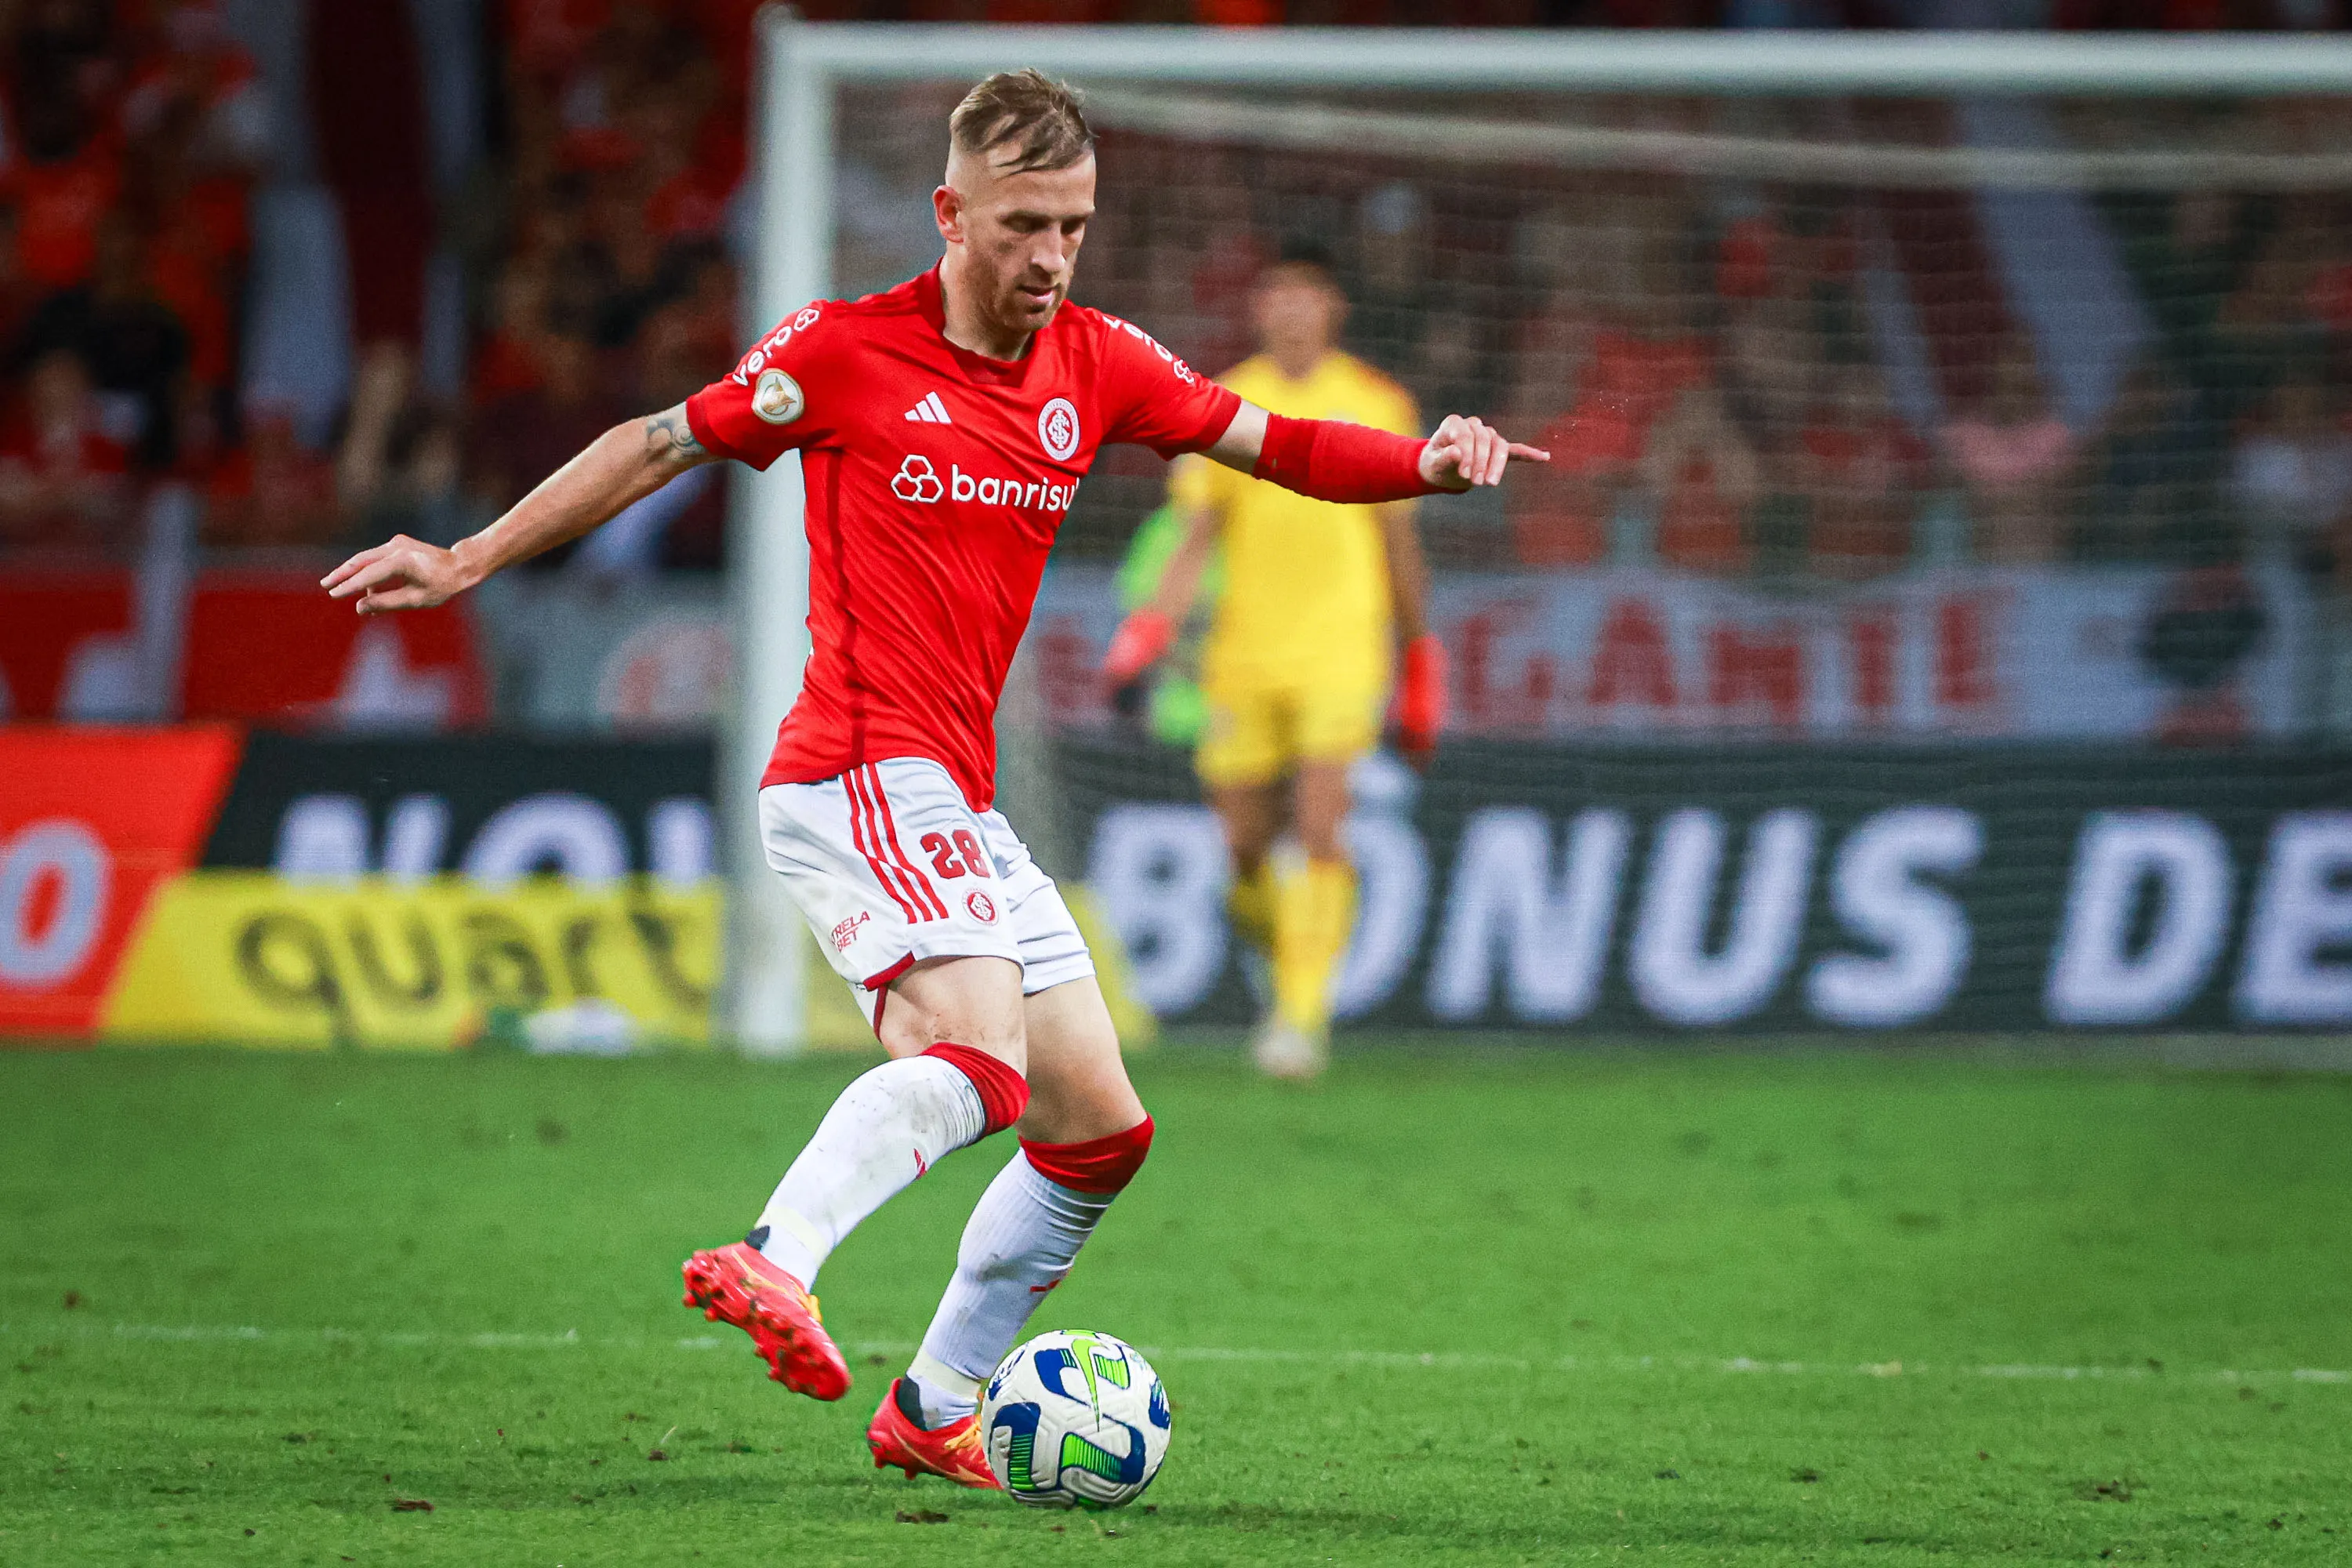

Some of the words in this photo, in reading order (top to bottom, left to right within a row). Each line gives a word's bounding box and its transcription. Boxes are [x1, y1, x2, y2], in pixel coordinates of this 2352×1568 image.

[732, 325, 792, 387] vero
[1102, 314, 1174, 363] vero
[920, 829, 991, 880] 28
[1088, 801, 1985, 1027] BONUS
[2043, 806, 2352, 1027] DE
[837, 926, 859, 954] BET
